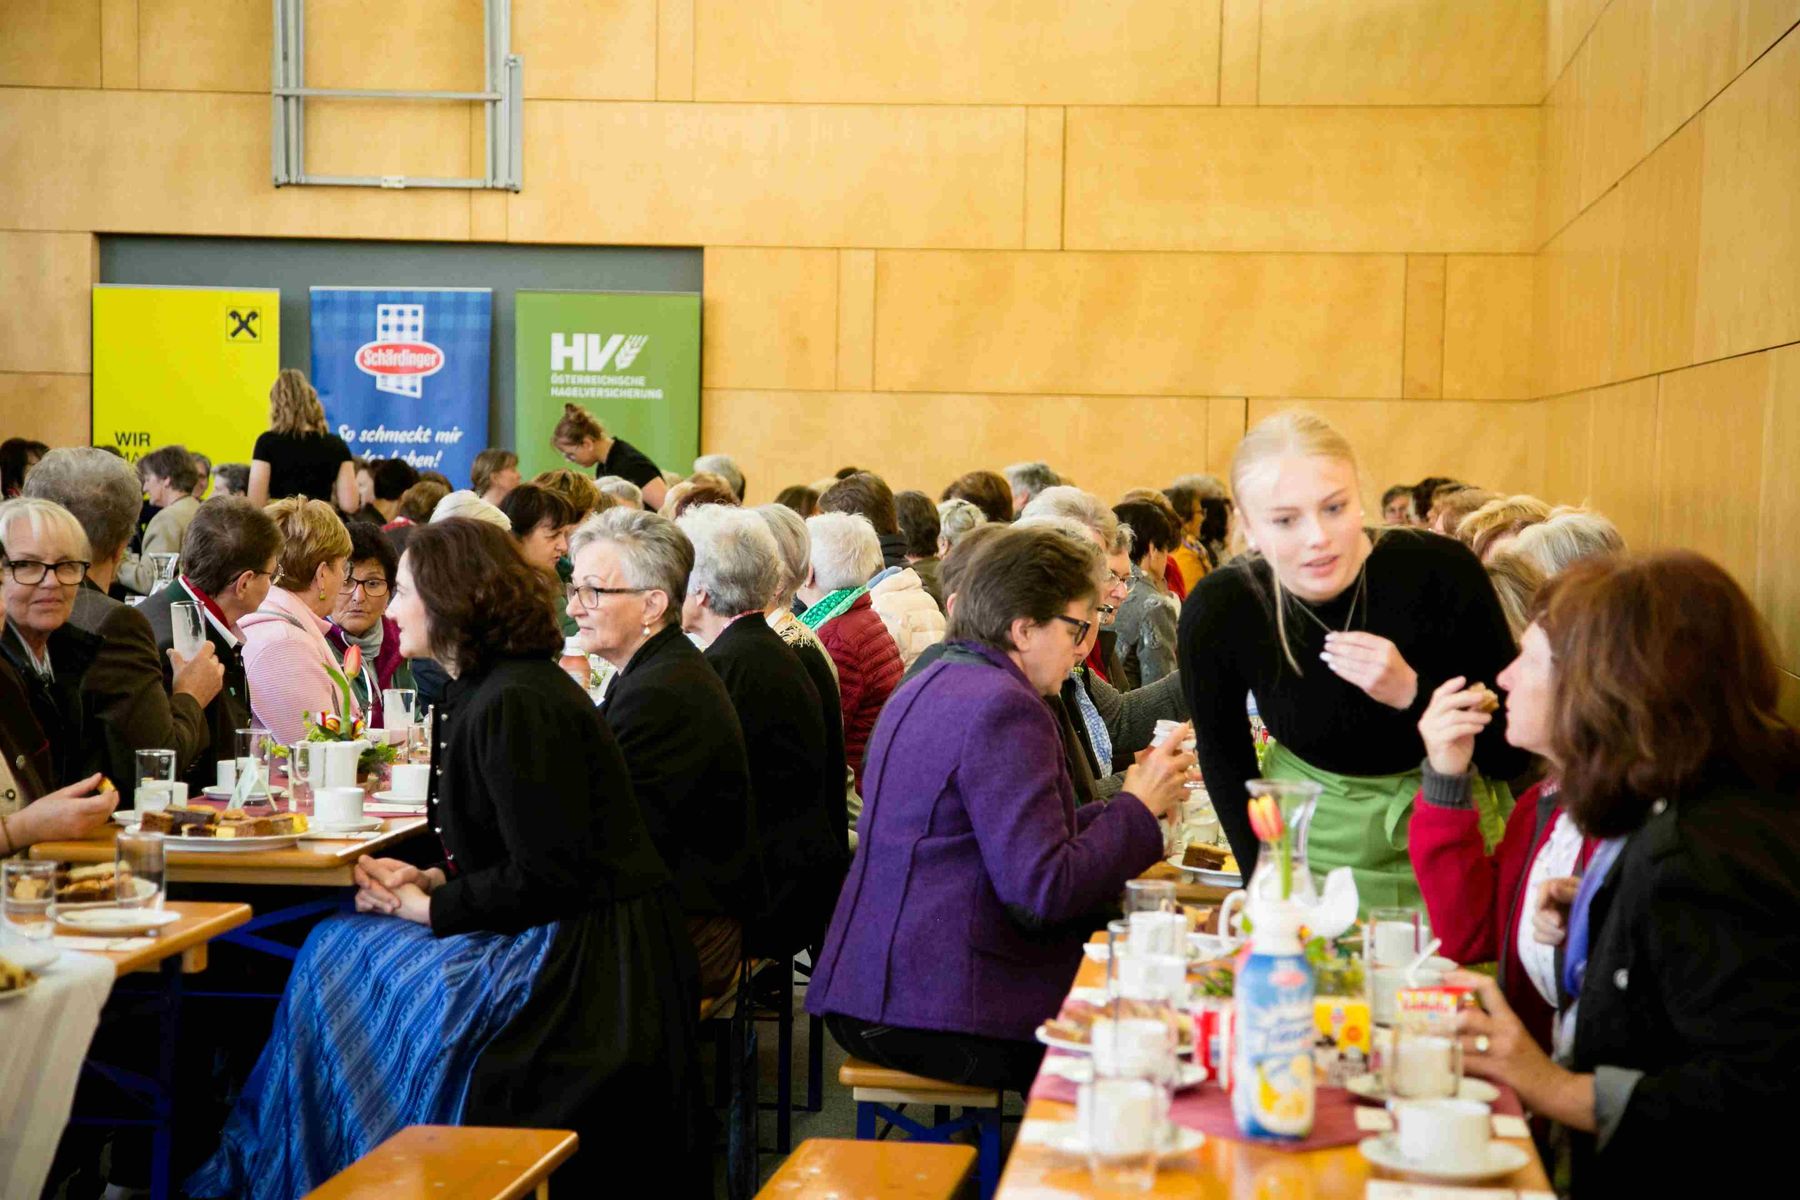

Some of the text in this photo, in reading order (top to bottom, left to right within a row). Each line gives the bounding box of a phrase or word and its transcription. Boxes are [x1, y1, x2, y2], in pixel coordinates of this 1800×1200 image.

[363, 349, 437, 367] Schärdinger
[551, 332, 625, 371] HV
[551, 373, 645, 386] ÖSTERREICHISCHE
[551, 387, 663, 399] HAGELVERSICHERUNG
[115, 432, 150, 446] WIR
[338, 424, 464, 444] So schmeckt mir
